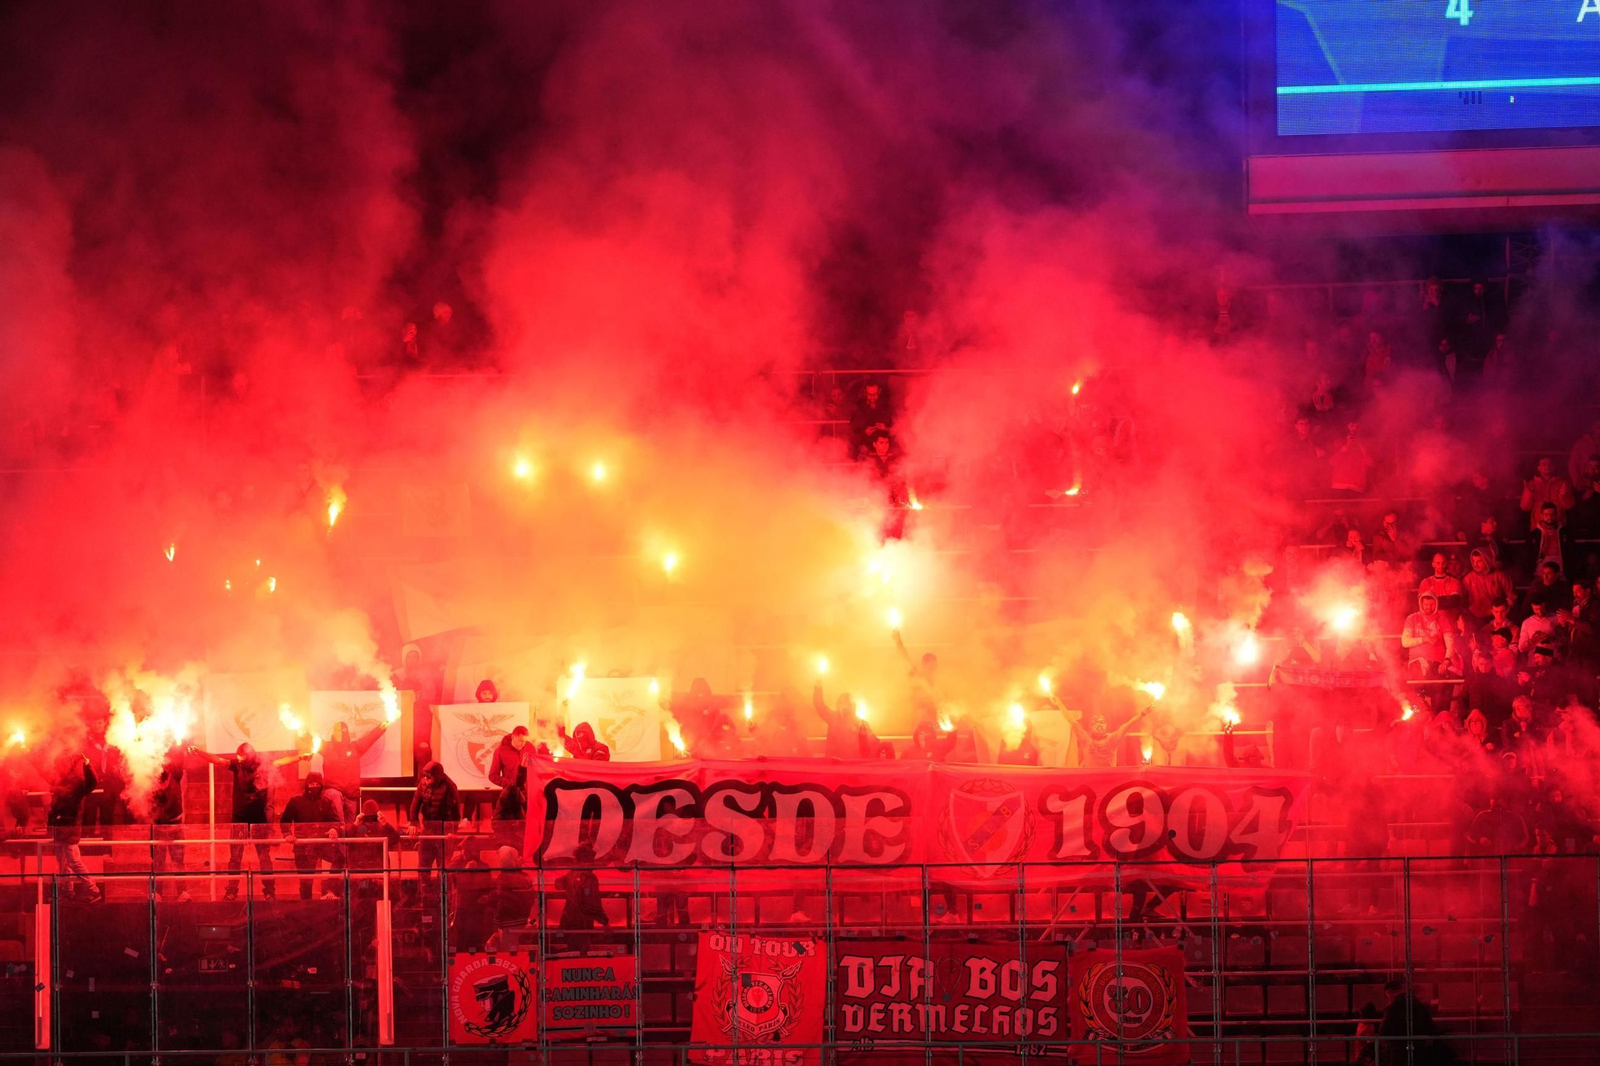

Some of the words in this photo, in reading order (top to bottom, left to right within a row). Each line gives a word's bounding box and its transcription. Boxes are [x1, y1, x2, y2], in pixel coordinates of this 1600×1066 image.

[1445, 0, 1474, 26] 4
[539, 784, 909, 865] DESDE
[1043, 783, 1292, 864] 1904
[709, 933, 743, 953] ON
[750, 938, 815, 957] TOUR
[452, 957, 490, 993] GUARDA
[491, 957, 517, 973] 982
[561, 966, 616, 982] NUNCA
[542, 982, 639, 1003] CAMINHARÁS
[451, 995, 468, 1024] NOVA
[704, 1047, 804, 1066] PARIS
